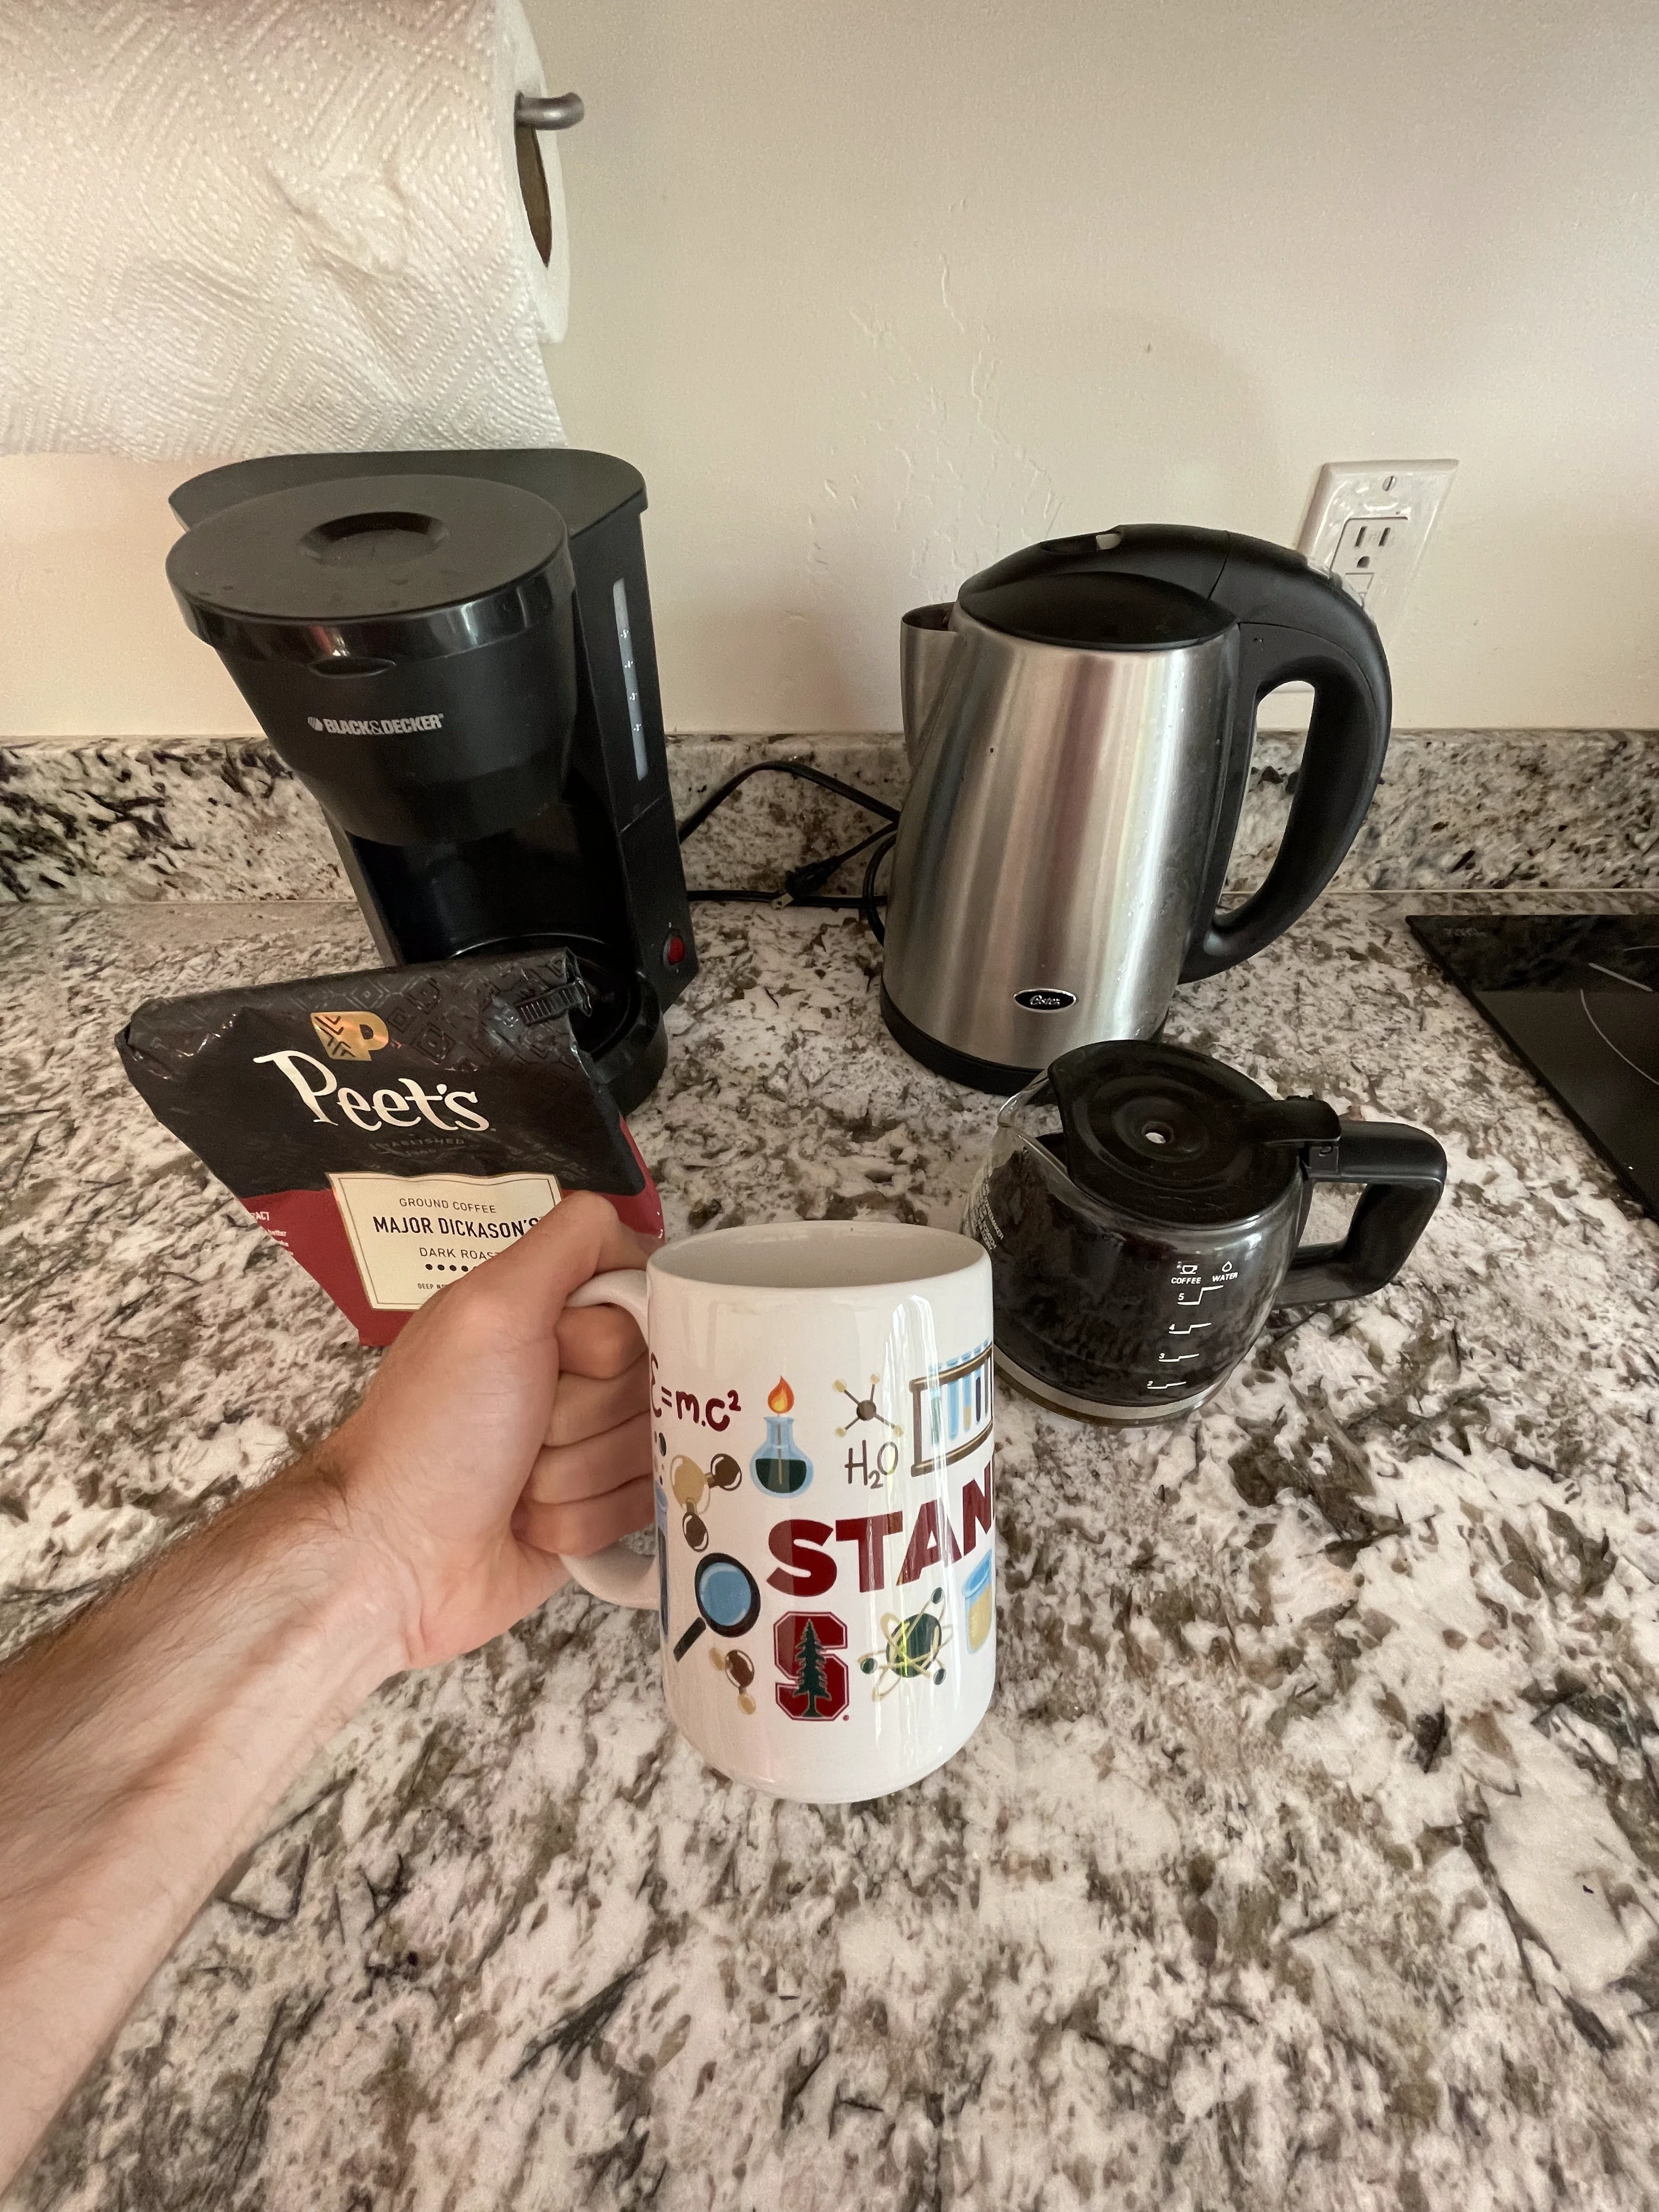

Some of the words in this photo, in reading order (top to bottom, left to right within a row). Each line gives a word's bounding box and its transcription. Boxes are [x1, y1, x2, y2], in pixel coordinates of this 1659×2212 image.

[252, 1050, 490, 1132] Peet's
[399, 1198, 449, 1209] GROUND
[453, 1201, 497, 1214] COFFEE
[373, 1216, 434, 1234] MAJOR
[419, 1246, 456, 1259] DARK
[461, 1249, 500, 1260] ROAS
[1212, 1272, 1238, 1283] WATER
[1178, 1293, 1185, 1301] 5
[766, 1457, 994, 1598] STAN
